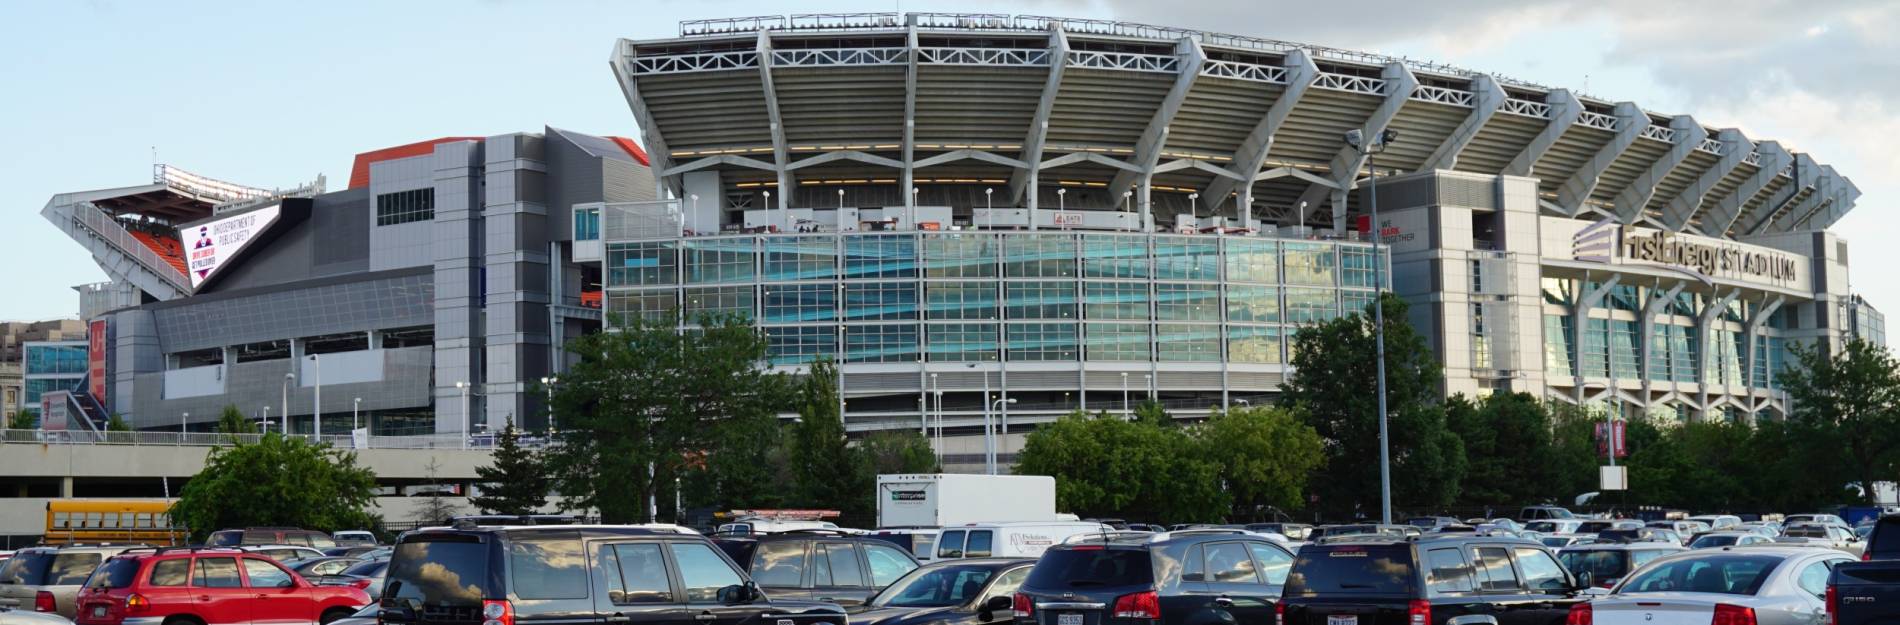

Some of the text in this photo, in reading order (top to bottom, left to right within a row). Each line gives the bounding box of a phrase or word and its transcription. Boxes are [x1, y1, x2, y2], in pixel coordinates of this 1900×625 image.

[222, 216, 250, 233] DEPARTMENT
[219, 229, 250, 246] PUBLIC SAFETY
[1621, 223, 1796, 282] FirstEnergy STADIUM
